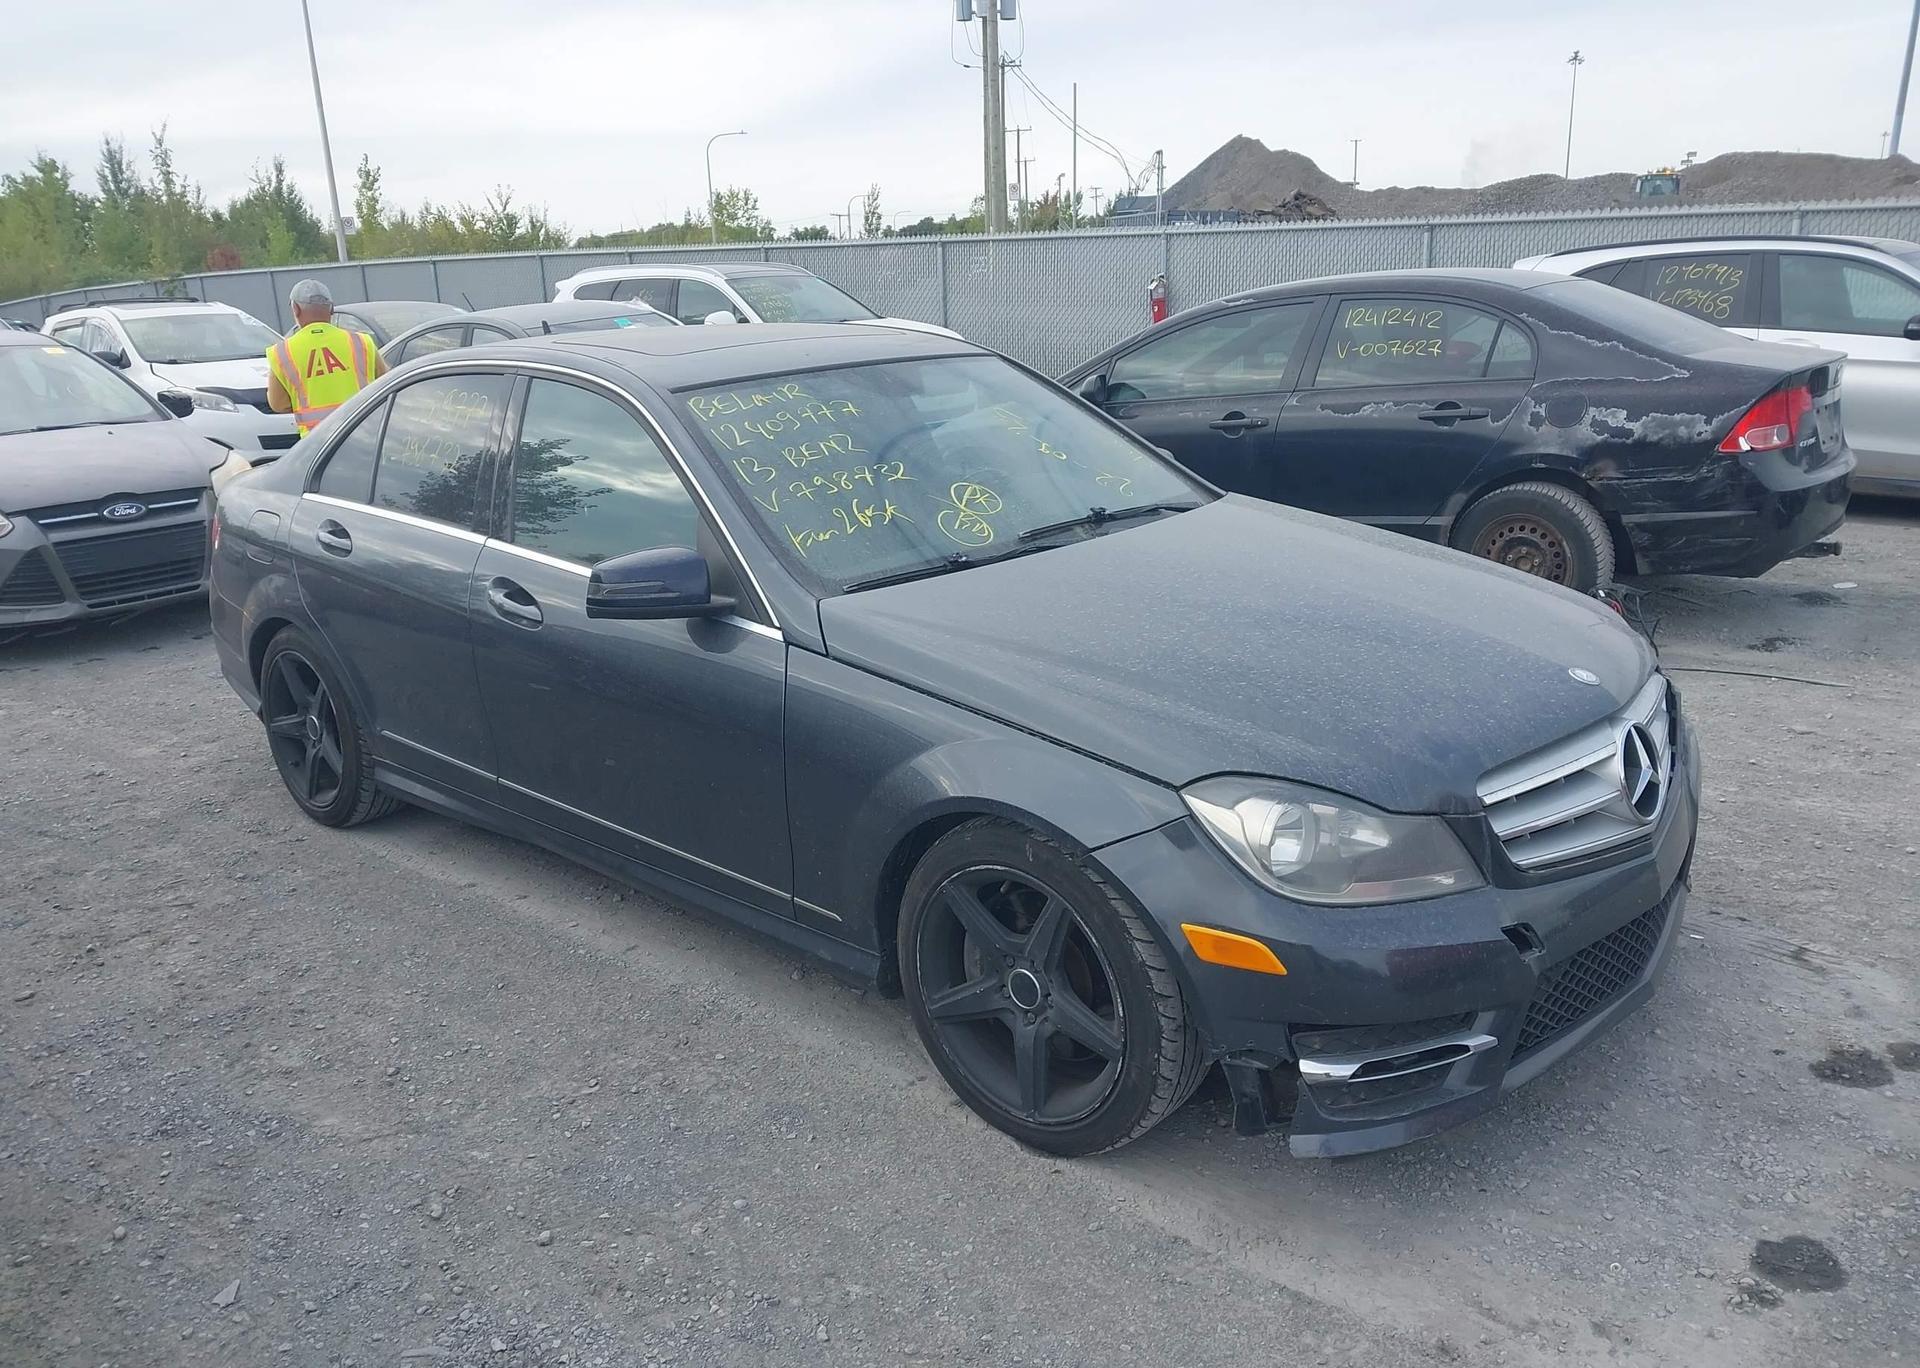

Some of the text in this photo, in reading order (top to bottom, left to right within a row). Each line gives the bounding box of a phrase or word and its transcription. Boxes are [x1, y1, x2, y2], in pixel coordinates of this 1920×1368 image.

[1345, 307, 1443, 329] 12412412
[1337, 339, 1443, 358] V-007627
[710, 399, 862, 450] 12409777
[733, 433, 870, 485] 13 BENZ
[114, 505, 138, 516] Ford
